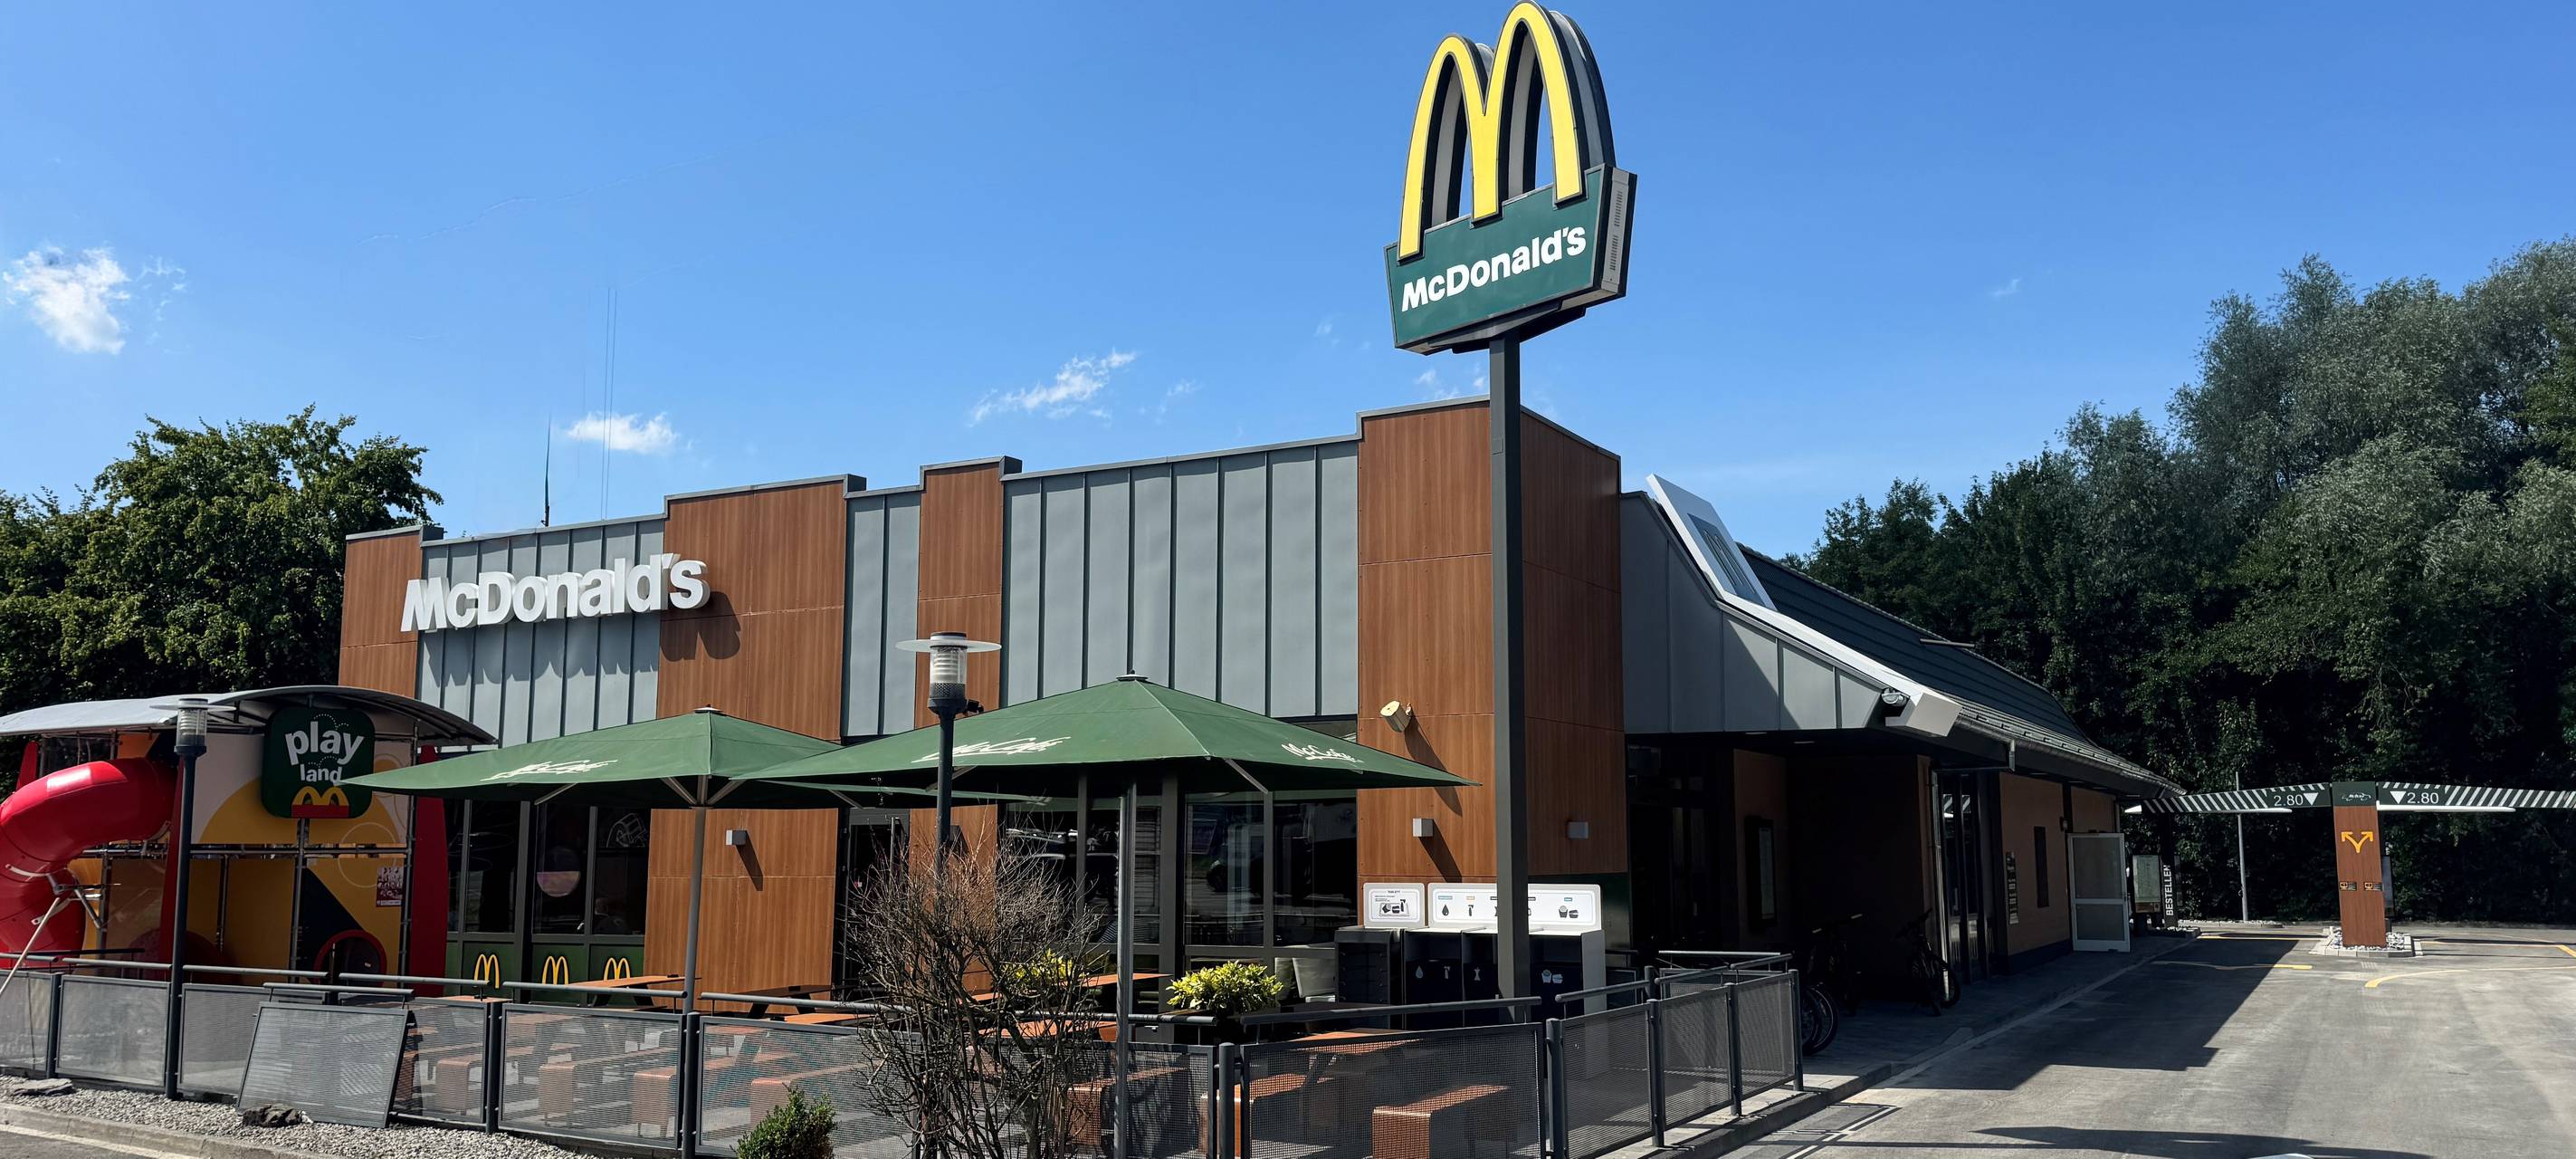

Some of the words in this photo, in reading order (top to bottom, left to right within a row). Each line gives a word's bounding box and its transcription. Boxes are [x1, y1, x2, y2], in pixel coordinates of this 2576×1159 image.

[1402, 226, 1587, 311] McDonald's
[400, 552, 711, 632] McDonald's
[285, 721, 365, 766] play
[300, 763, 343, 783] land
[2274, 794, 2304, 807] 2.80
[2407, 792, 2439, 804] 2.80
[2163, 865, 2173, 915] BESTELLEN
